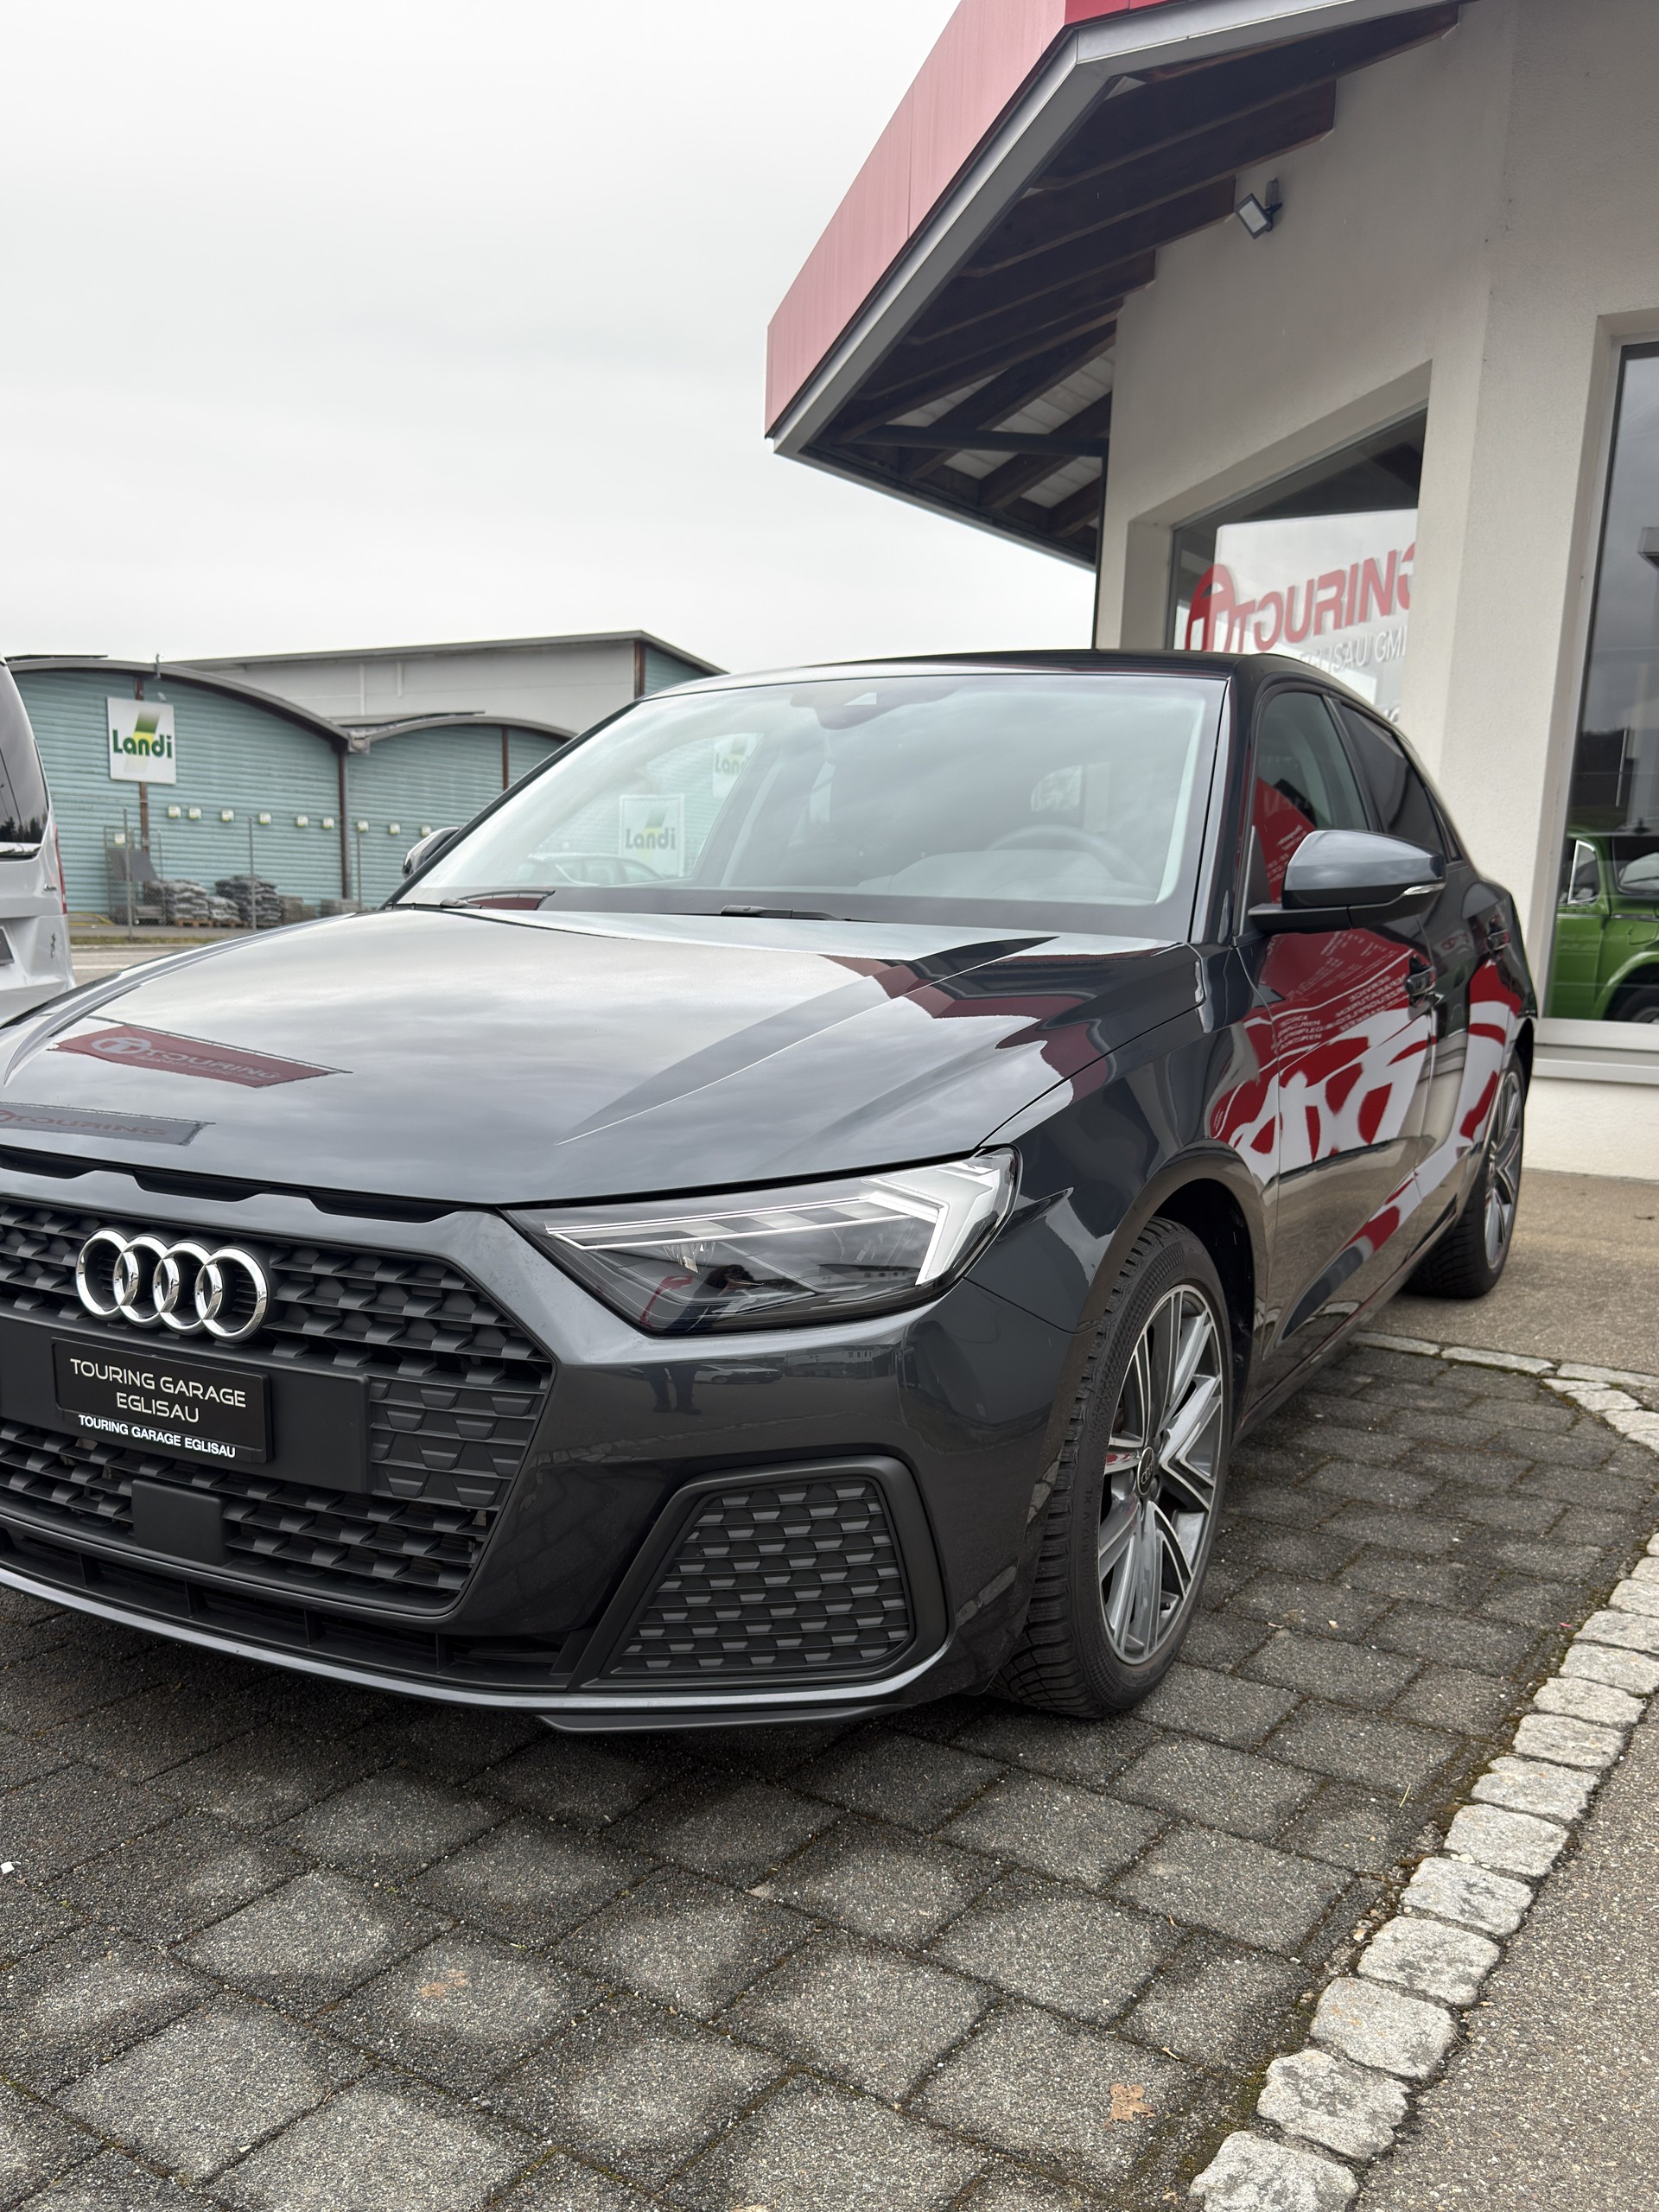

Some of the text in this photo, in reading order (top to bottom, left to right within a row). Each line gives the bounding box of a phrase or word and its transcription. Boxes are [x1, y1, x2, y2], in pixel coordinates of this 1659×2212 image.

[112, 729, 172, 759] Landi
[715, 752, 751, 776] Lan
[625, 827, 677, 850] Landi
[144, 1048, 281, 1079] TOURING
[70, 1358, 246, 1408] TOURING GARAGE
[117, 1392, 199, 1423] EGLISAU
[79, 1414, 236, 1458] TOURING GARAGE EGLISAU
